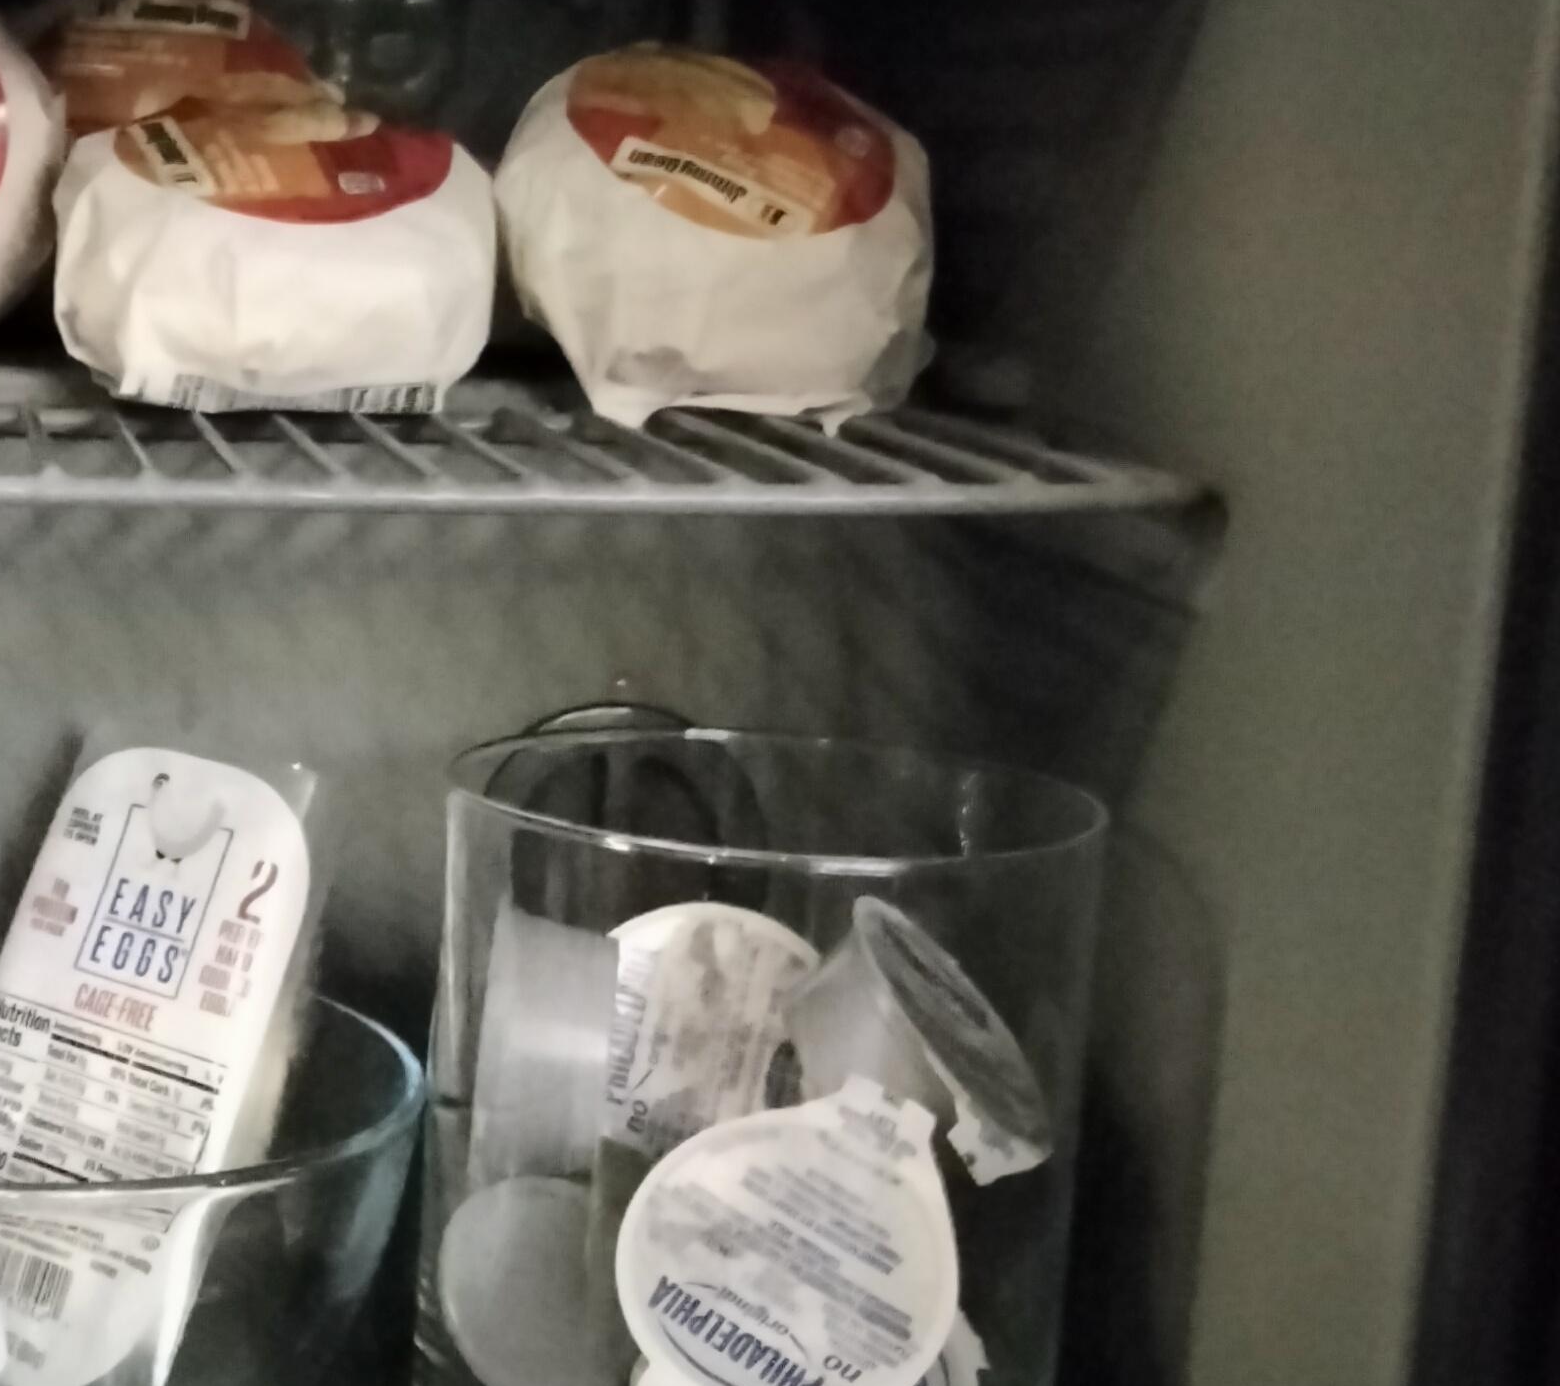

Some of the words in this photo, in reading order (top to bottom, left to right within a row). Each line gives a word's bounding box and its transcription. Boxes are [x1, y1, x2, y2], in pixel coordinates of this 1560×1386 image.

[109, 877, 198, 934] EASY
[237, 859, 279, 926] 2
[89, 924, 180, 984] EGGS
